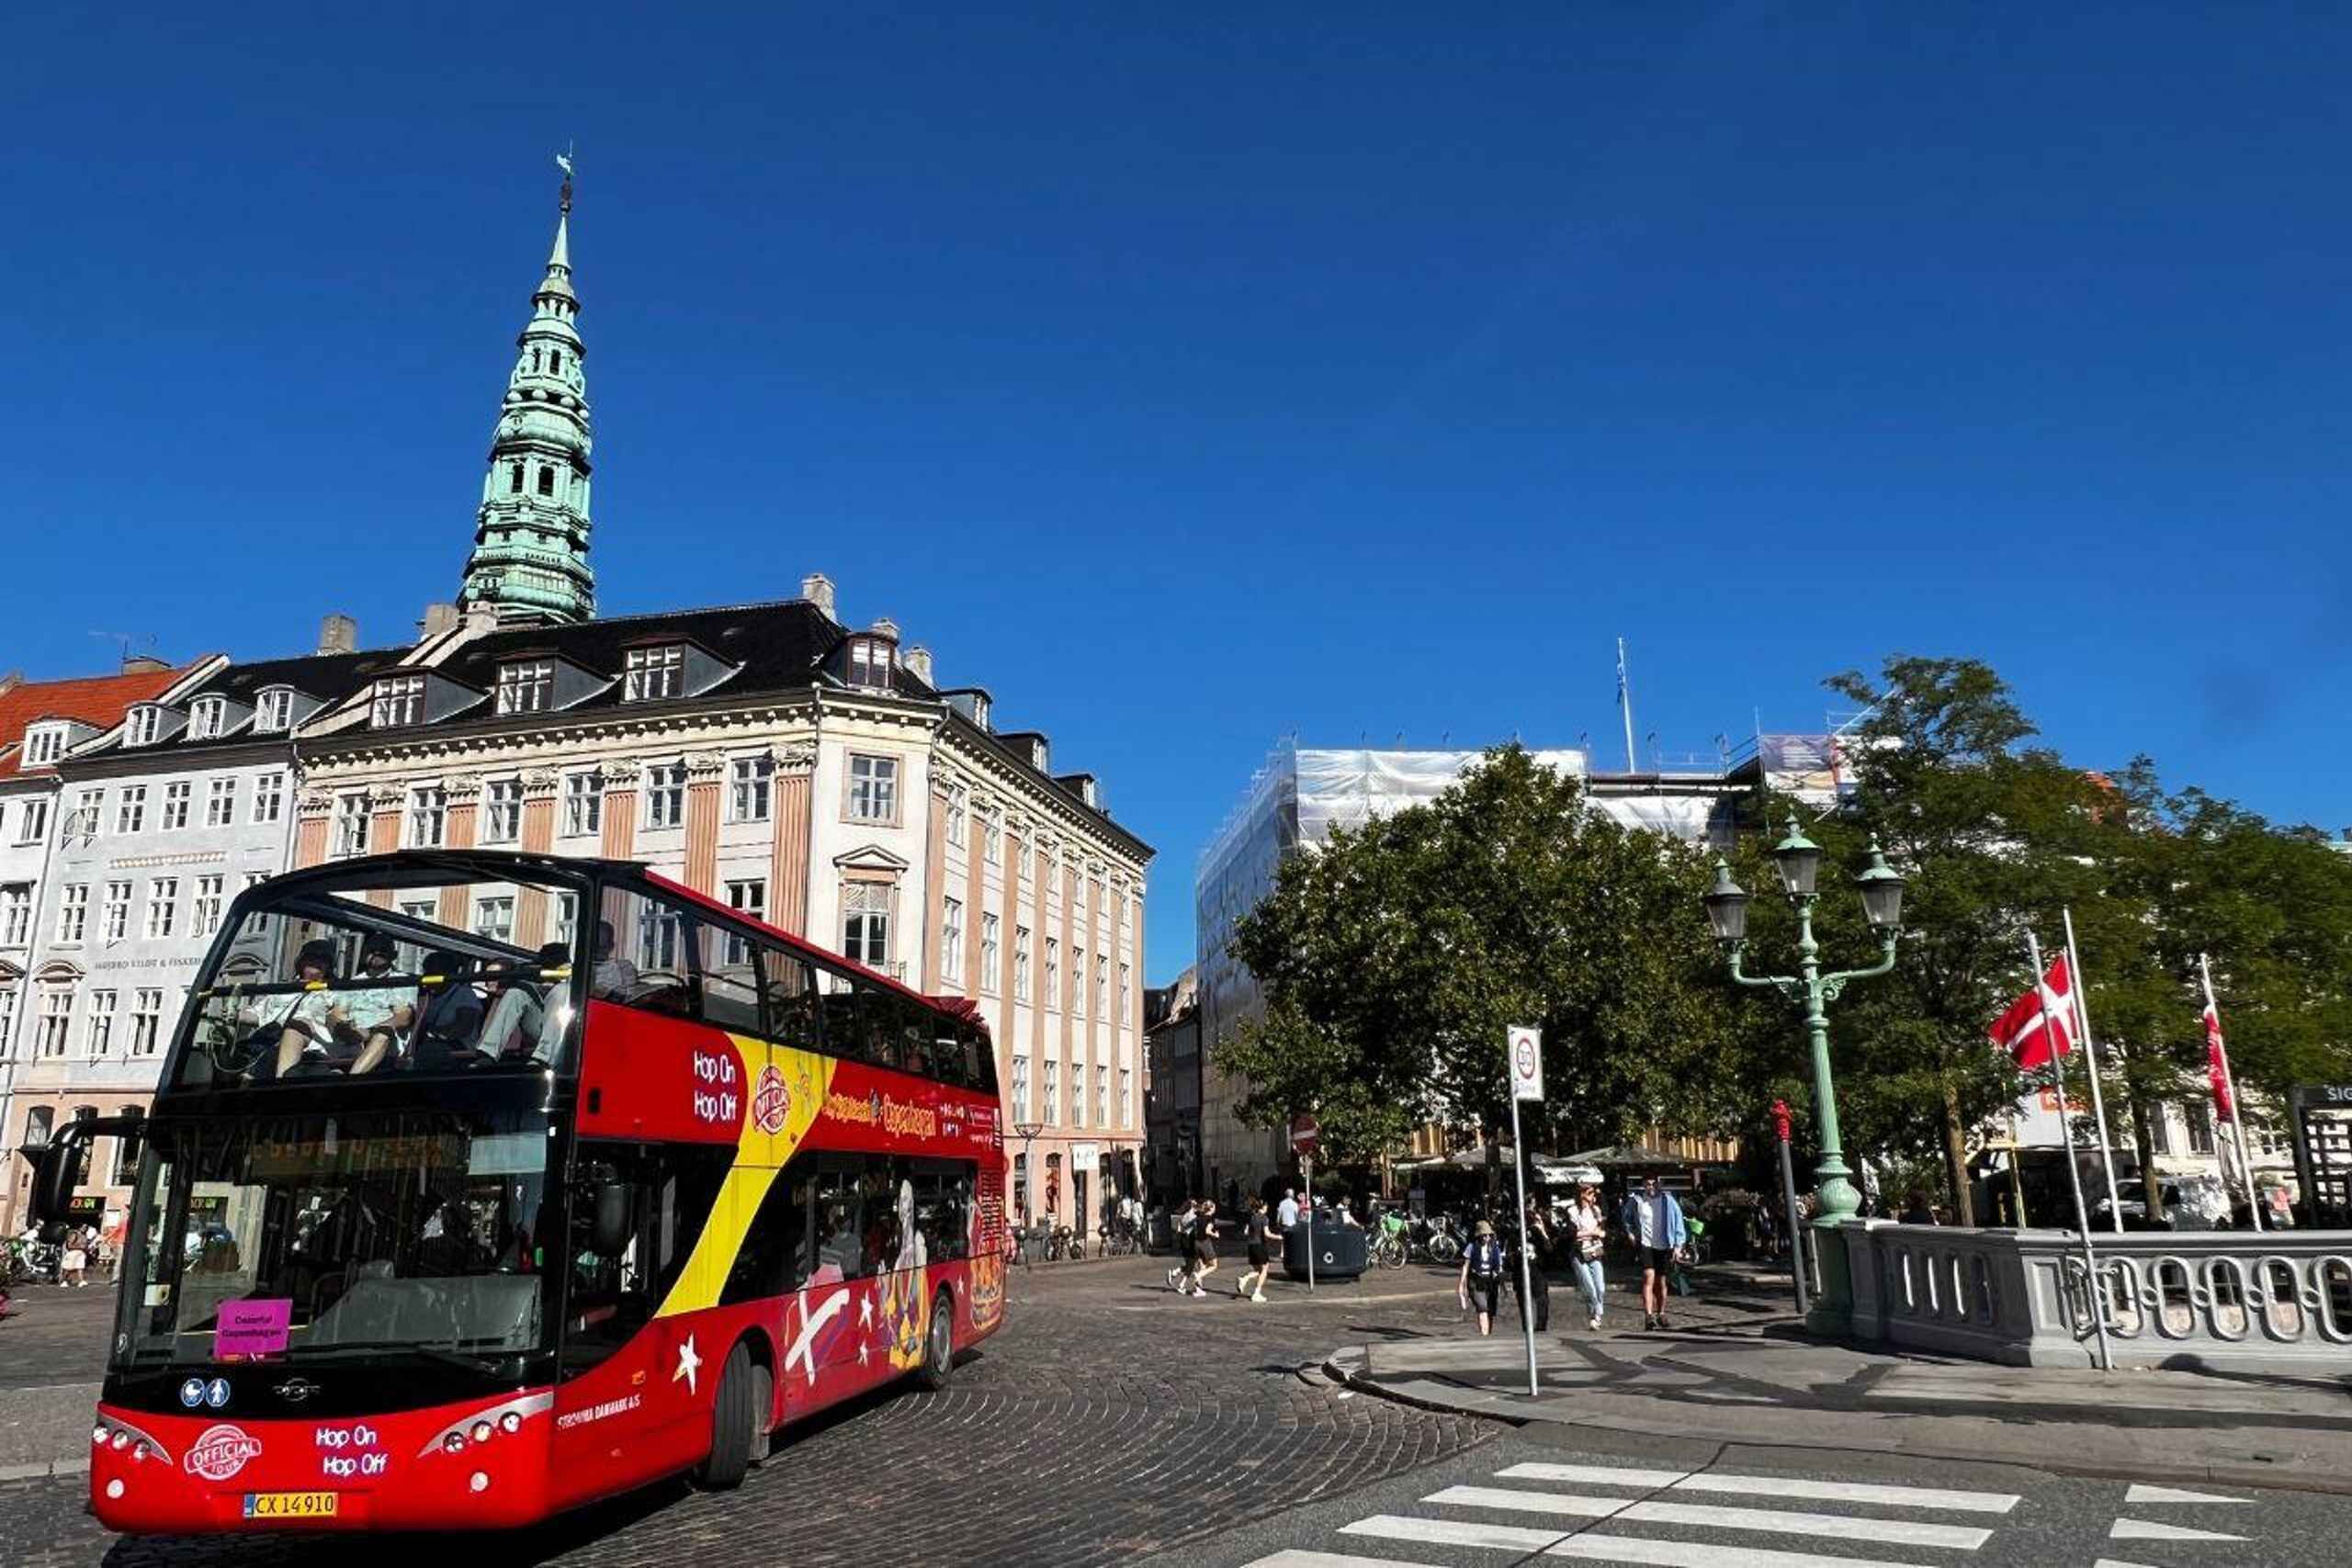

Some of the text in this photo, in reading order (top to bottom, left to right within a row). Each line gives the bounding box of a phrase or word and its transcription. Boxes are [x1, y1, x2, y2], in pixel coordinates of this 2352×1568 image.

[694, 1050, 735, 1084] Hop On
[694, 1090, 737, 1122] Hop Off
[316, 1425, 376, 1448] Hop On
[192, 1441, 254, 1464] OFFICIAL
[323, 1453, 388, 1477] Hop Off
